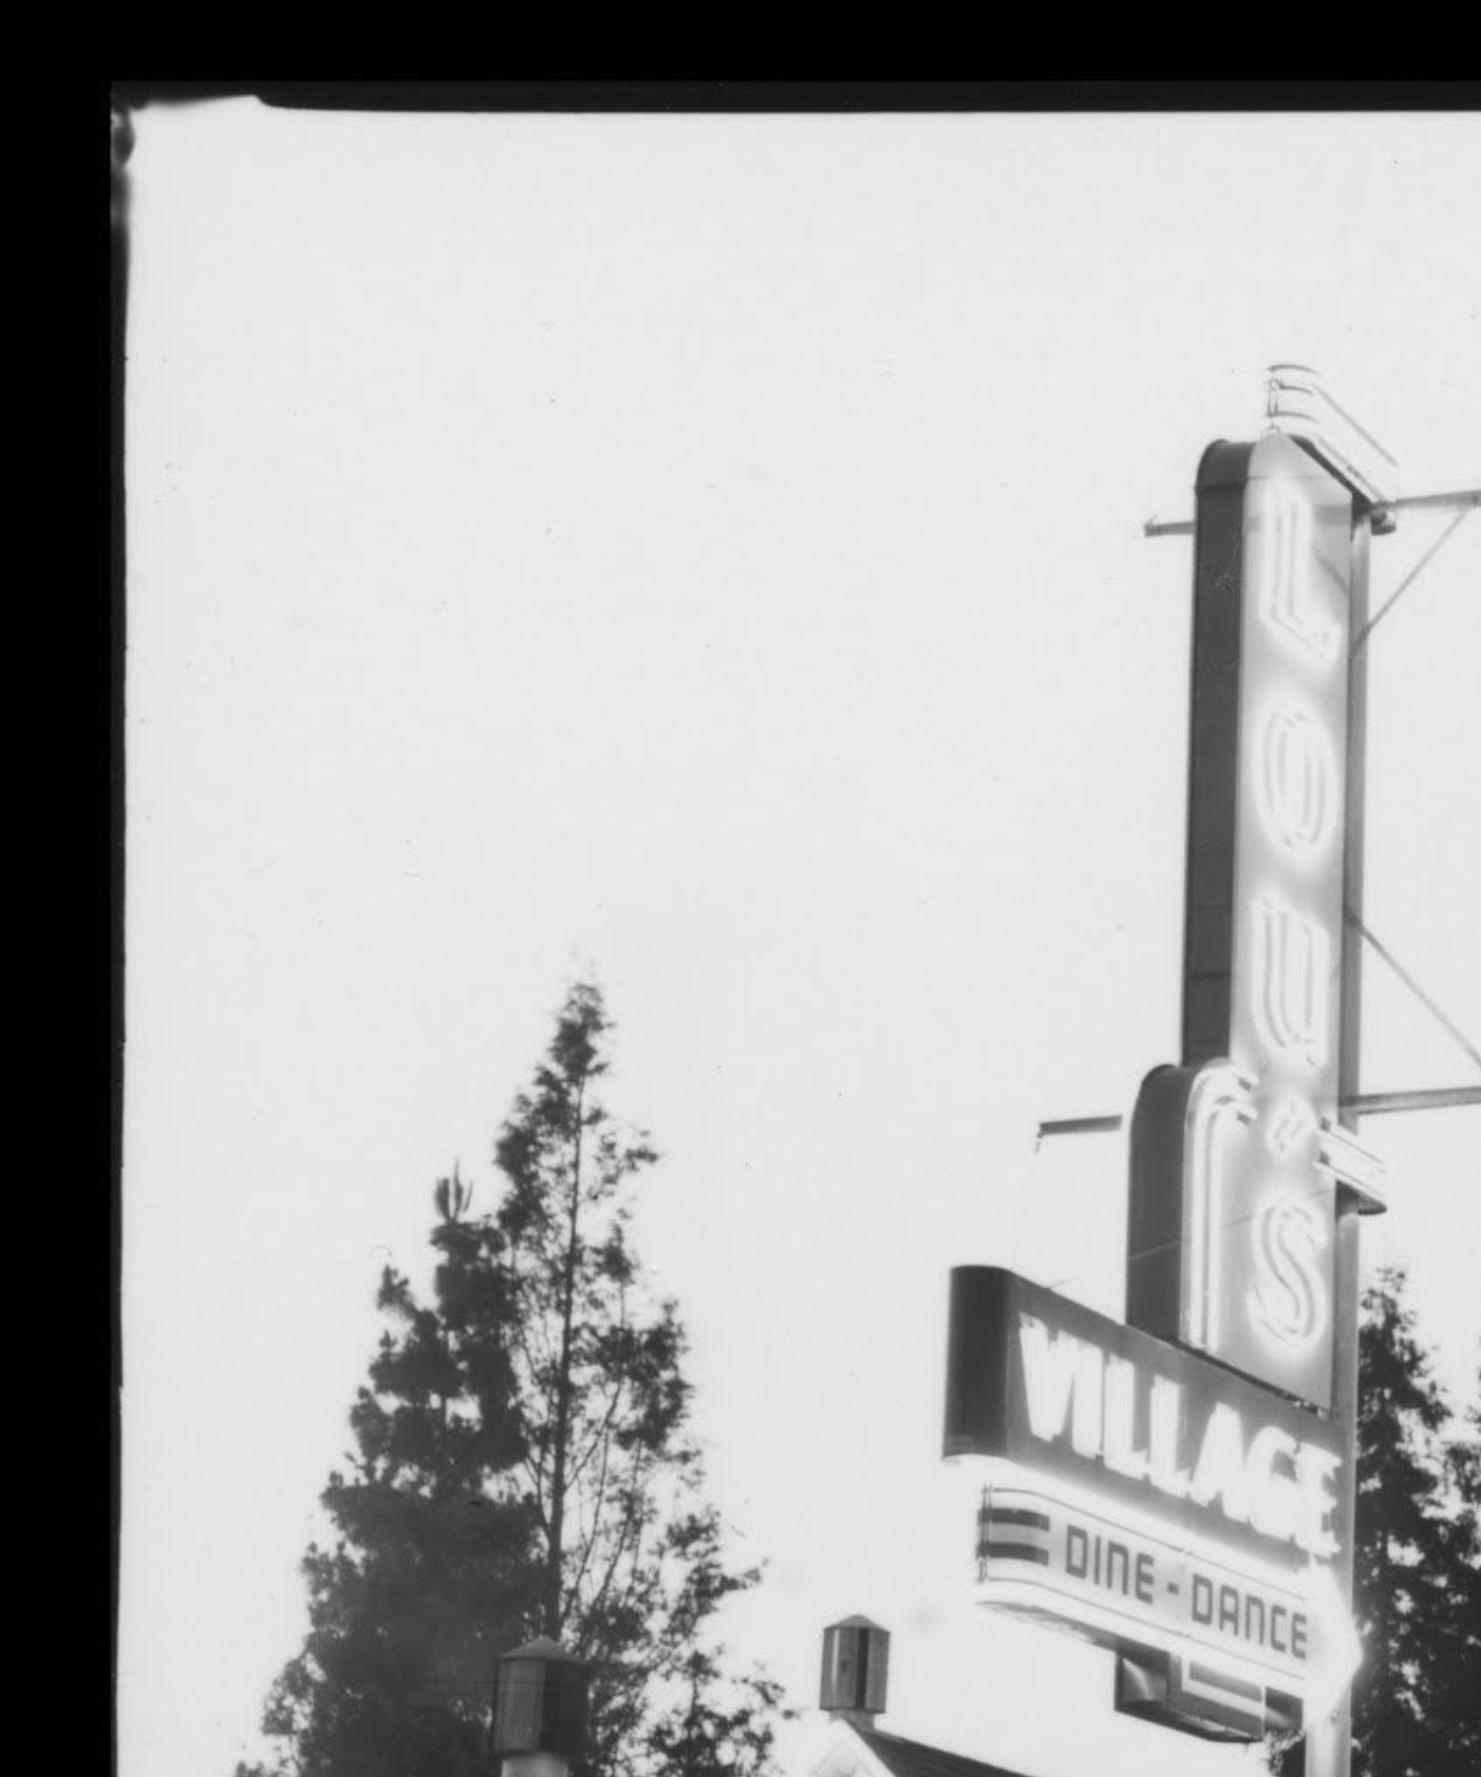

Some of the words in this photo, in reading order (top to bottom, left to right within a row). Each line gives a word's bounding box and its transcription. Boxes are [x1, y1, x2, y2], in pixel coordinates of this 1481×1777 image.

[1018, 1311, 1344, 1558] VILLAGE
[1065, 1523, 1156, 1605] DINE
[1191, 1573, 1308, 1661] DANCE
